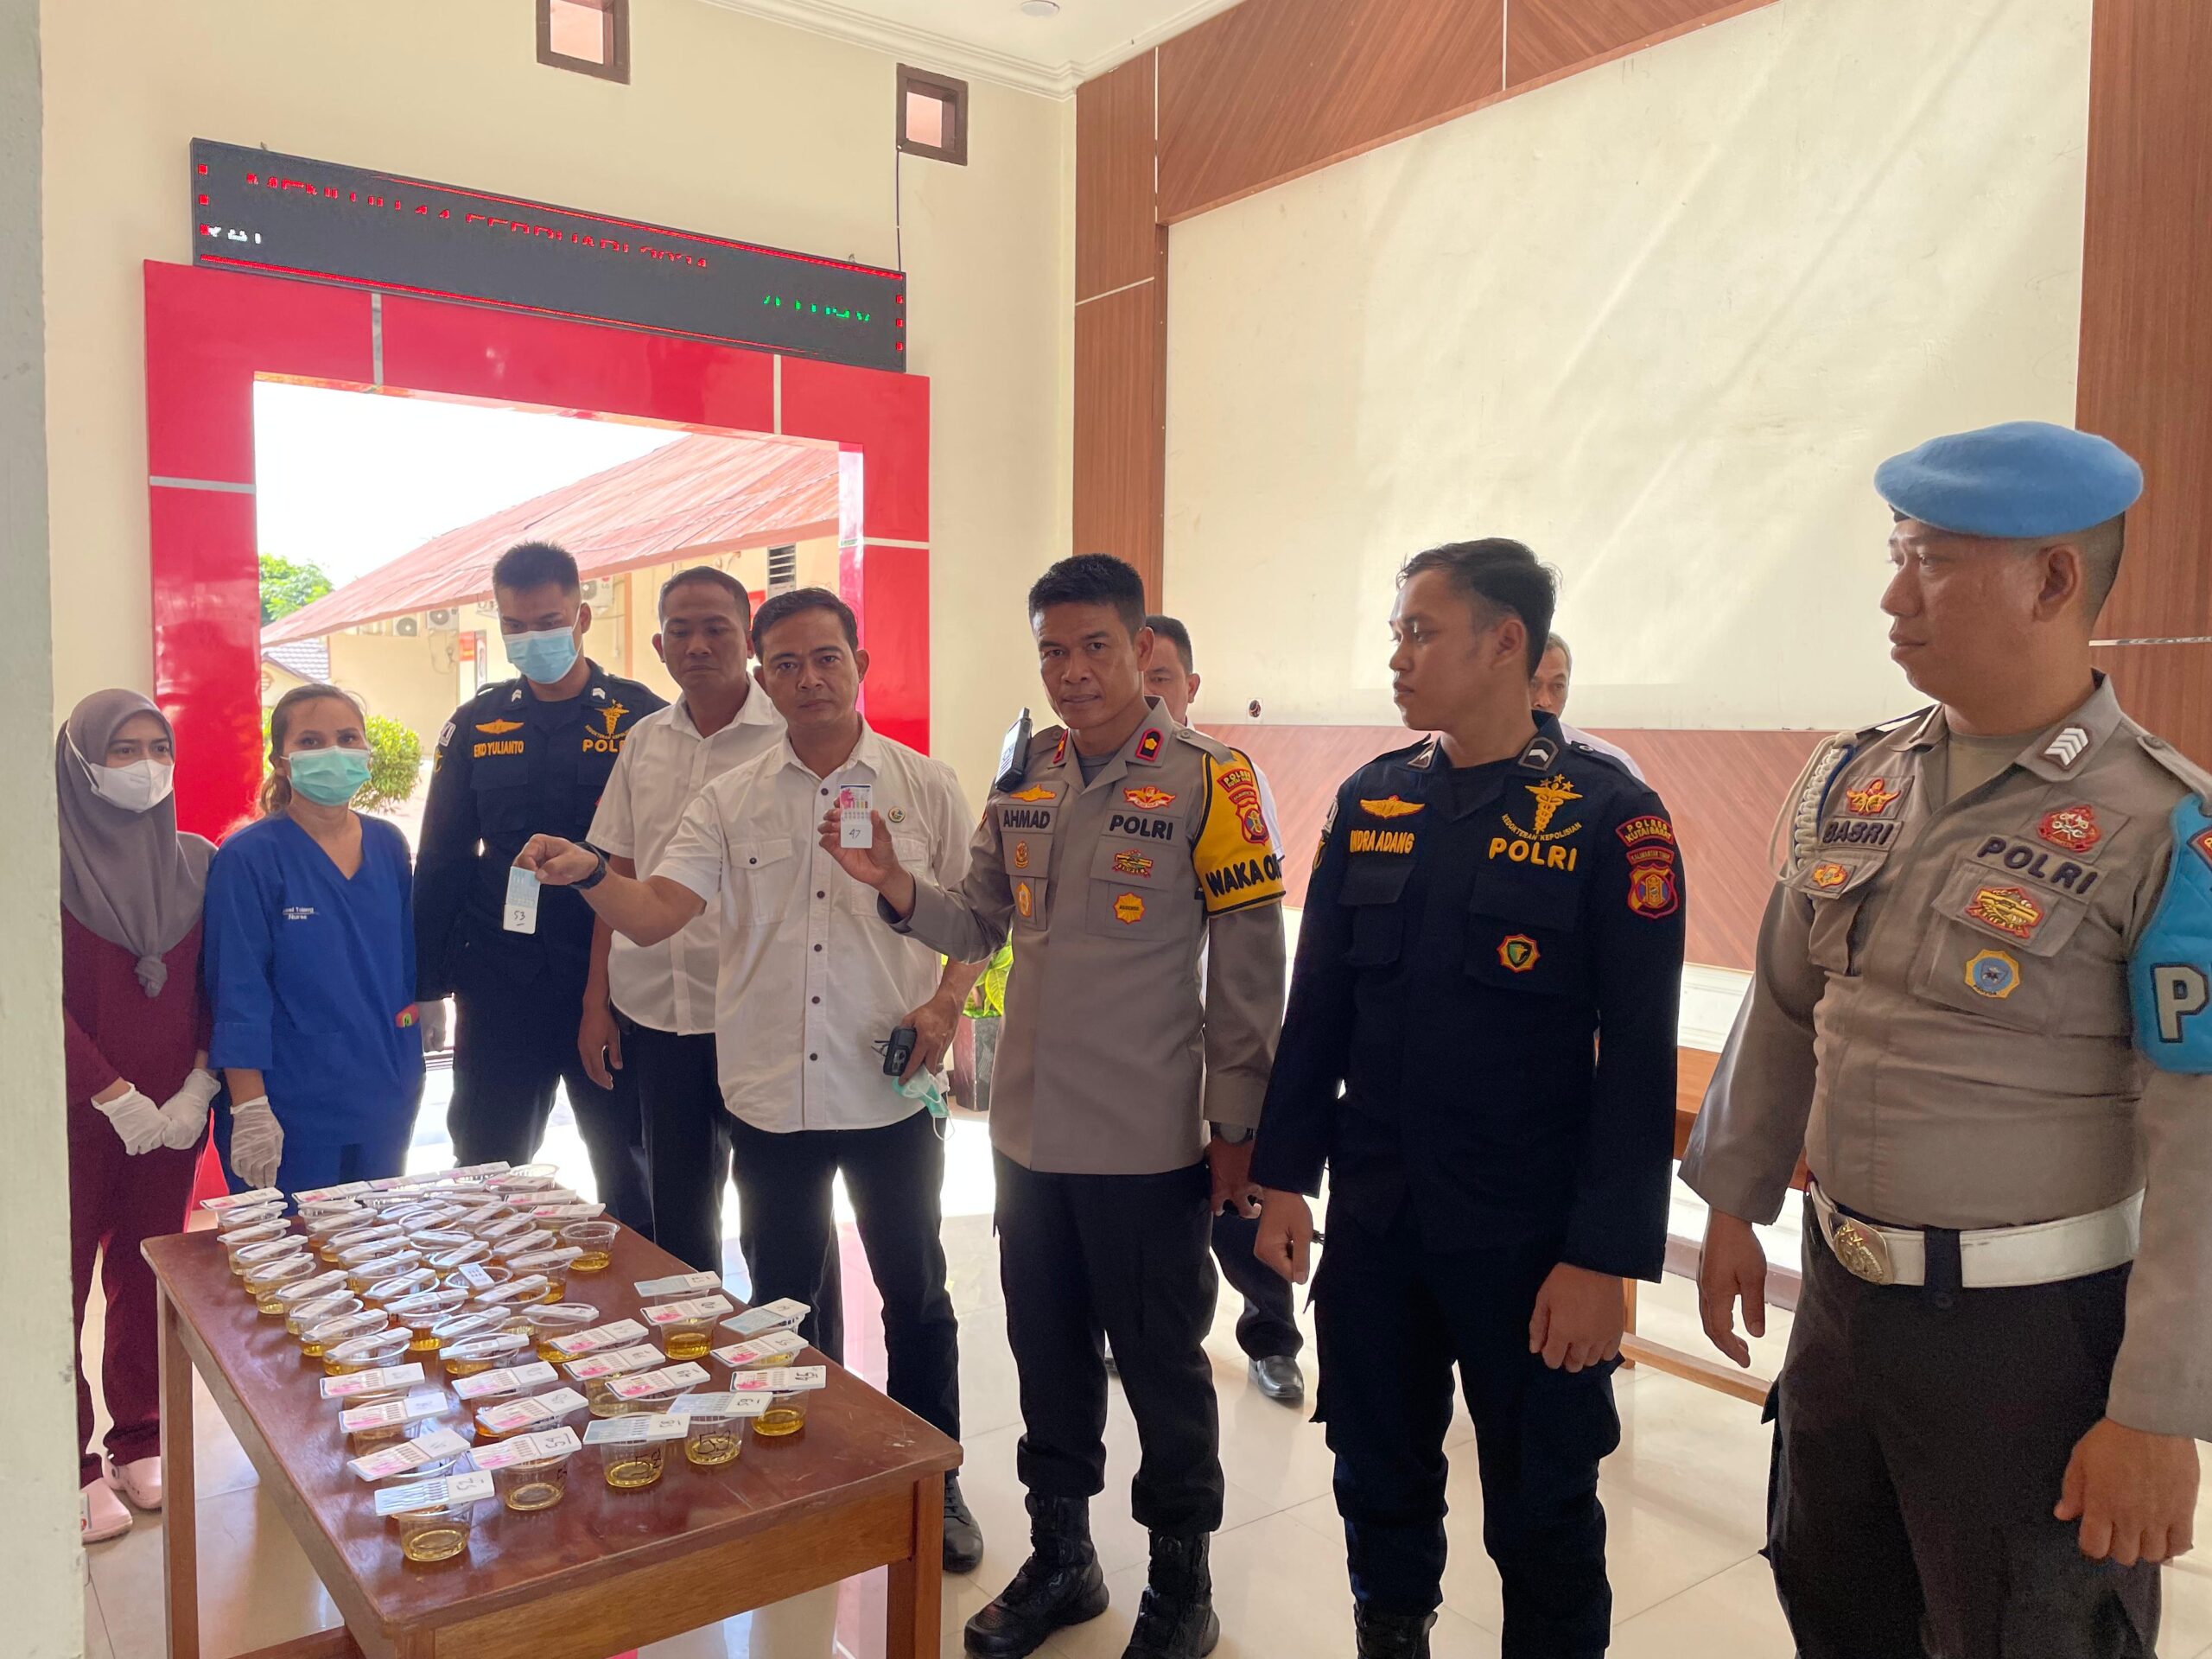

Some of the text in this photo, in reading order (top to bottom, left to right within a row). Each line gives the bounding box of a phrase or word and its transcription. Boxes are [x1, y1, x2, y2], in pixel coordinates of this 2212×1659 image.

[487, 740, 524, 756] YULIANTO
[1003, 810, 1050, 830] AHMAD
[1109, 815, 1173, 840] POLRI
[1350, 830, 1415, 855] INDRA ADANG
[1540, 822, 1583, 841] KEPOLISIAN
[1822, 820, 1894, 845] BASRI
[1489, 837, 1578, 872] POLRI
[1977, 836, 2098, 894] POLRI
[1205, 859, 1264, 898] WAKA
[513, 910, 525, 921] 53
[545, 1434, 567, 1449] 54
[456, 1478, 475, 1491] 52
